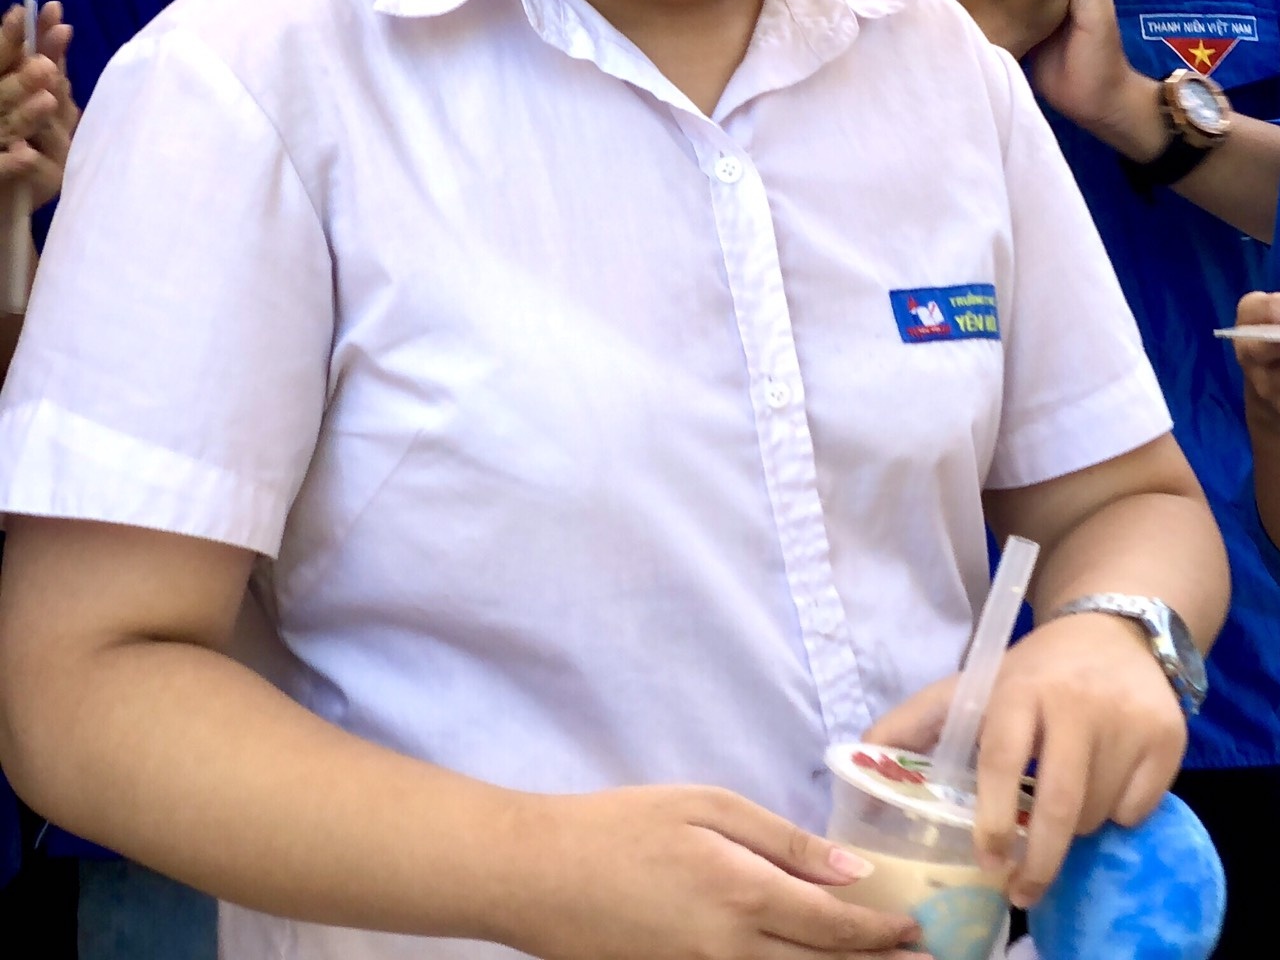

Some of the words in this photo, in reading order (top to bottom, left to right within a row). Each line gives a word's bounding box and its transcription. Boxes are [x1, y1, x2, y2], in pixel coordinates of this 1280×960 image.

[1147, 21, 1181, 33] THANH
[1183, 19, 1206, 33] NIÊN
[1207, 19, 1229, 36] VIỆT
[1231, 22, 1253, 34] NAM
[954, 309, 984, 332] YÊN
